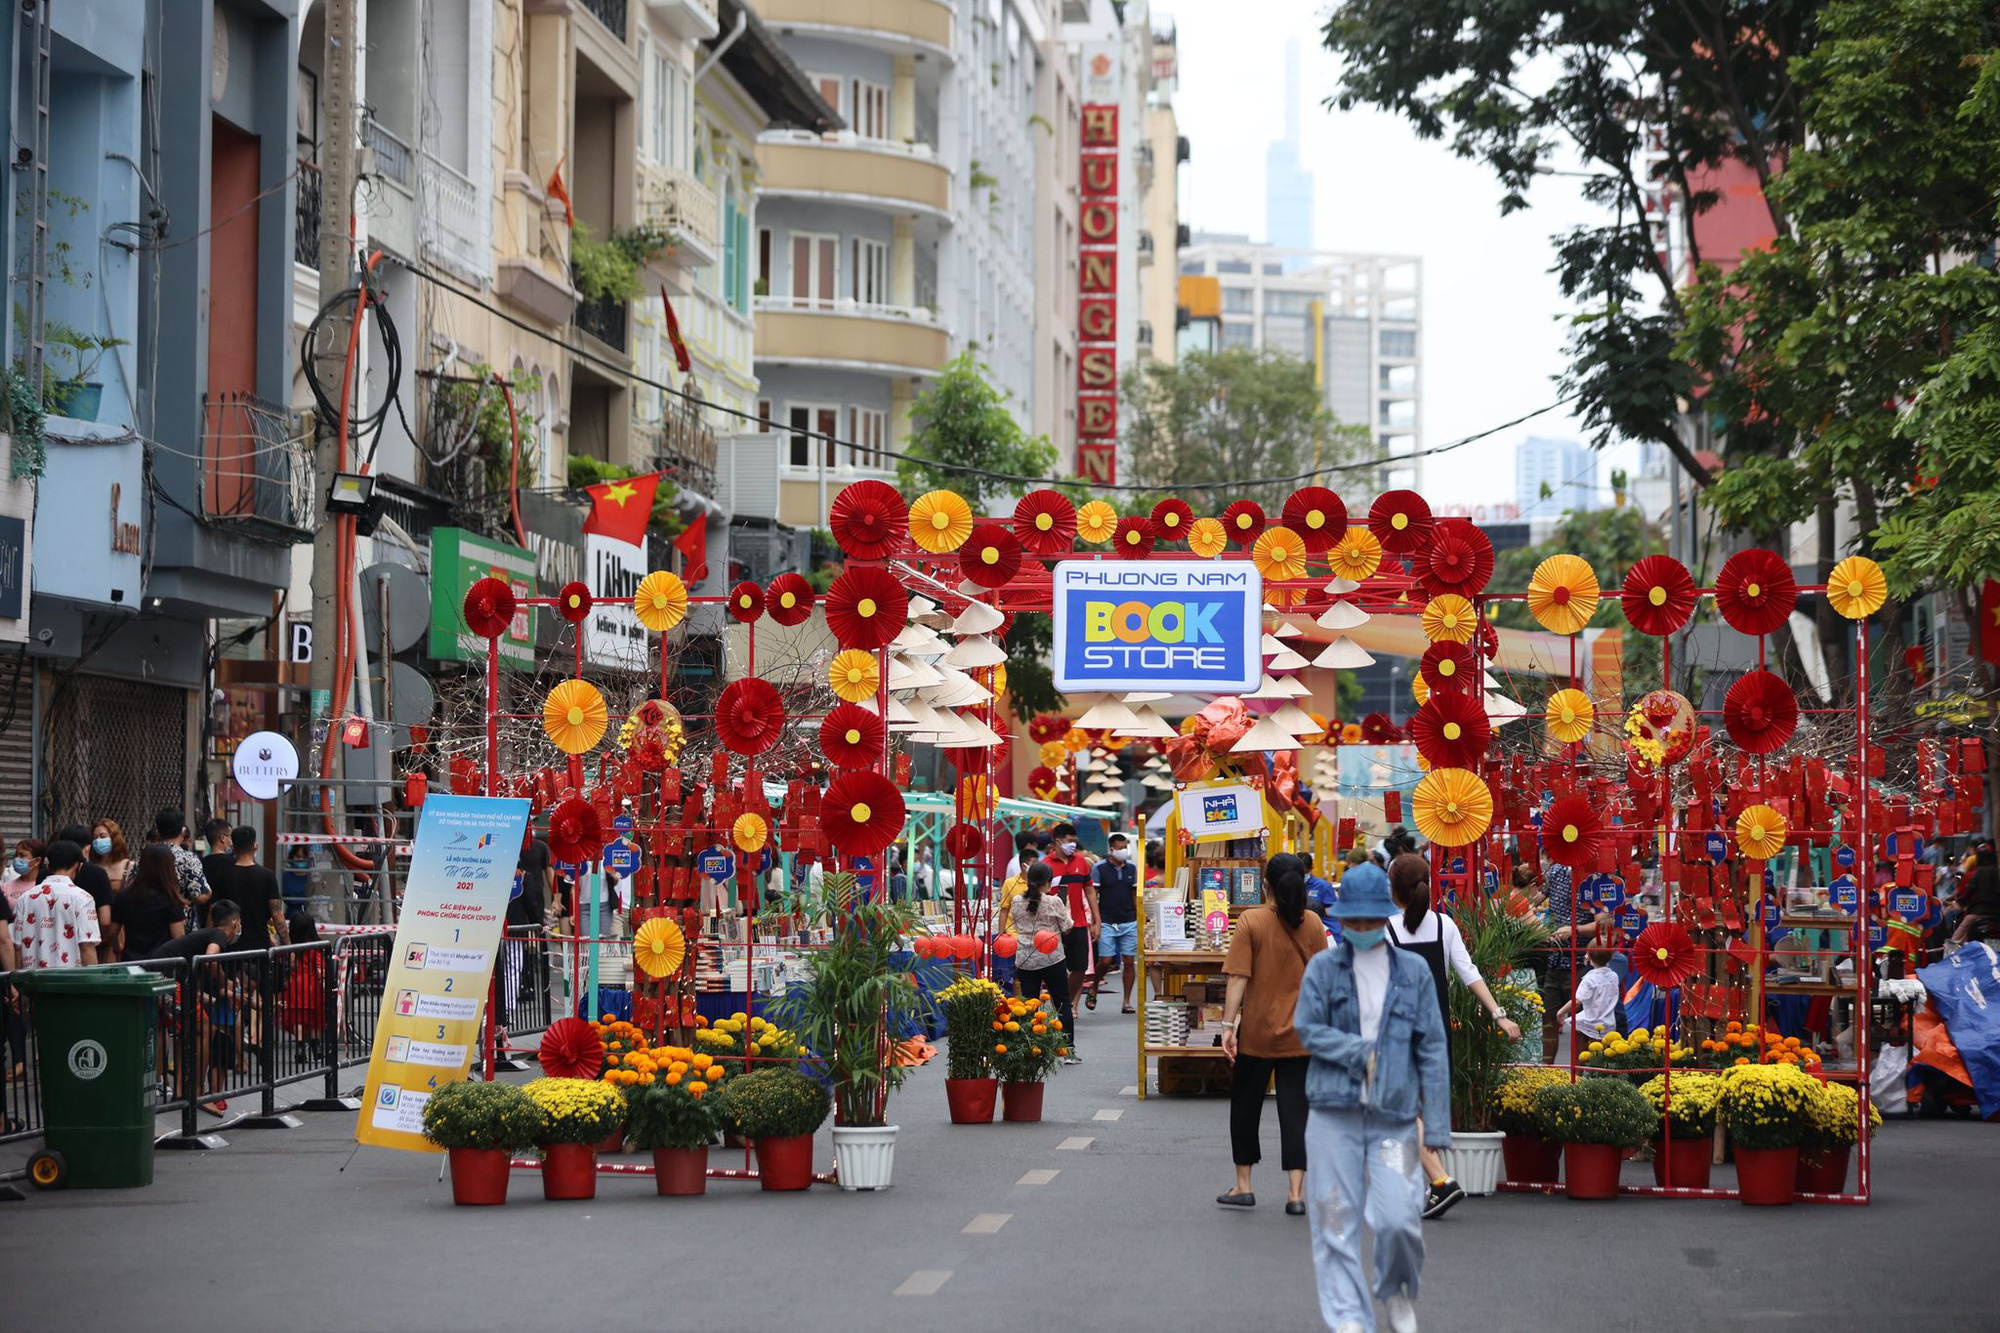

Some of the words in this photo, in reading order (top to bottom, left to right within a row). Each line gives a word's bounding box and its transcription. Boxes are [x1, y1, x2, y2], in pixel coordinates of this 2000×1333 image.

[1066, 571, 1177, 586] PHUONG
[1187, 572, 1247, 586] NAM
[1085, 601, 1225, 643] BOOK
[1084, 646, 1226, 670] STORE
[239, 765, 290, 776] BUTTERY
[1205, 797, 1235, 808] NHÀ
[1206, 808, 1236, 822] SÁCH
[456, 882, 474, 890] 2021
[455, 928, 460, 942] 1
[408, 951, 424, 962] 5K
[444, 978, 453, 992] 2
[436, 1025, 446, 1039] 3
[428, 1074, 438, 1088] 4
